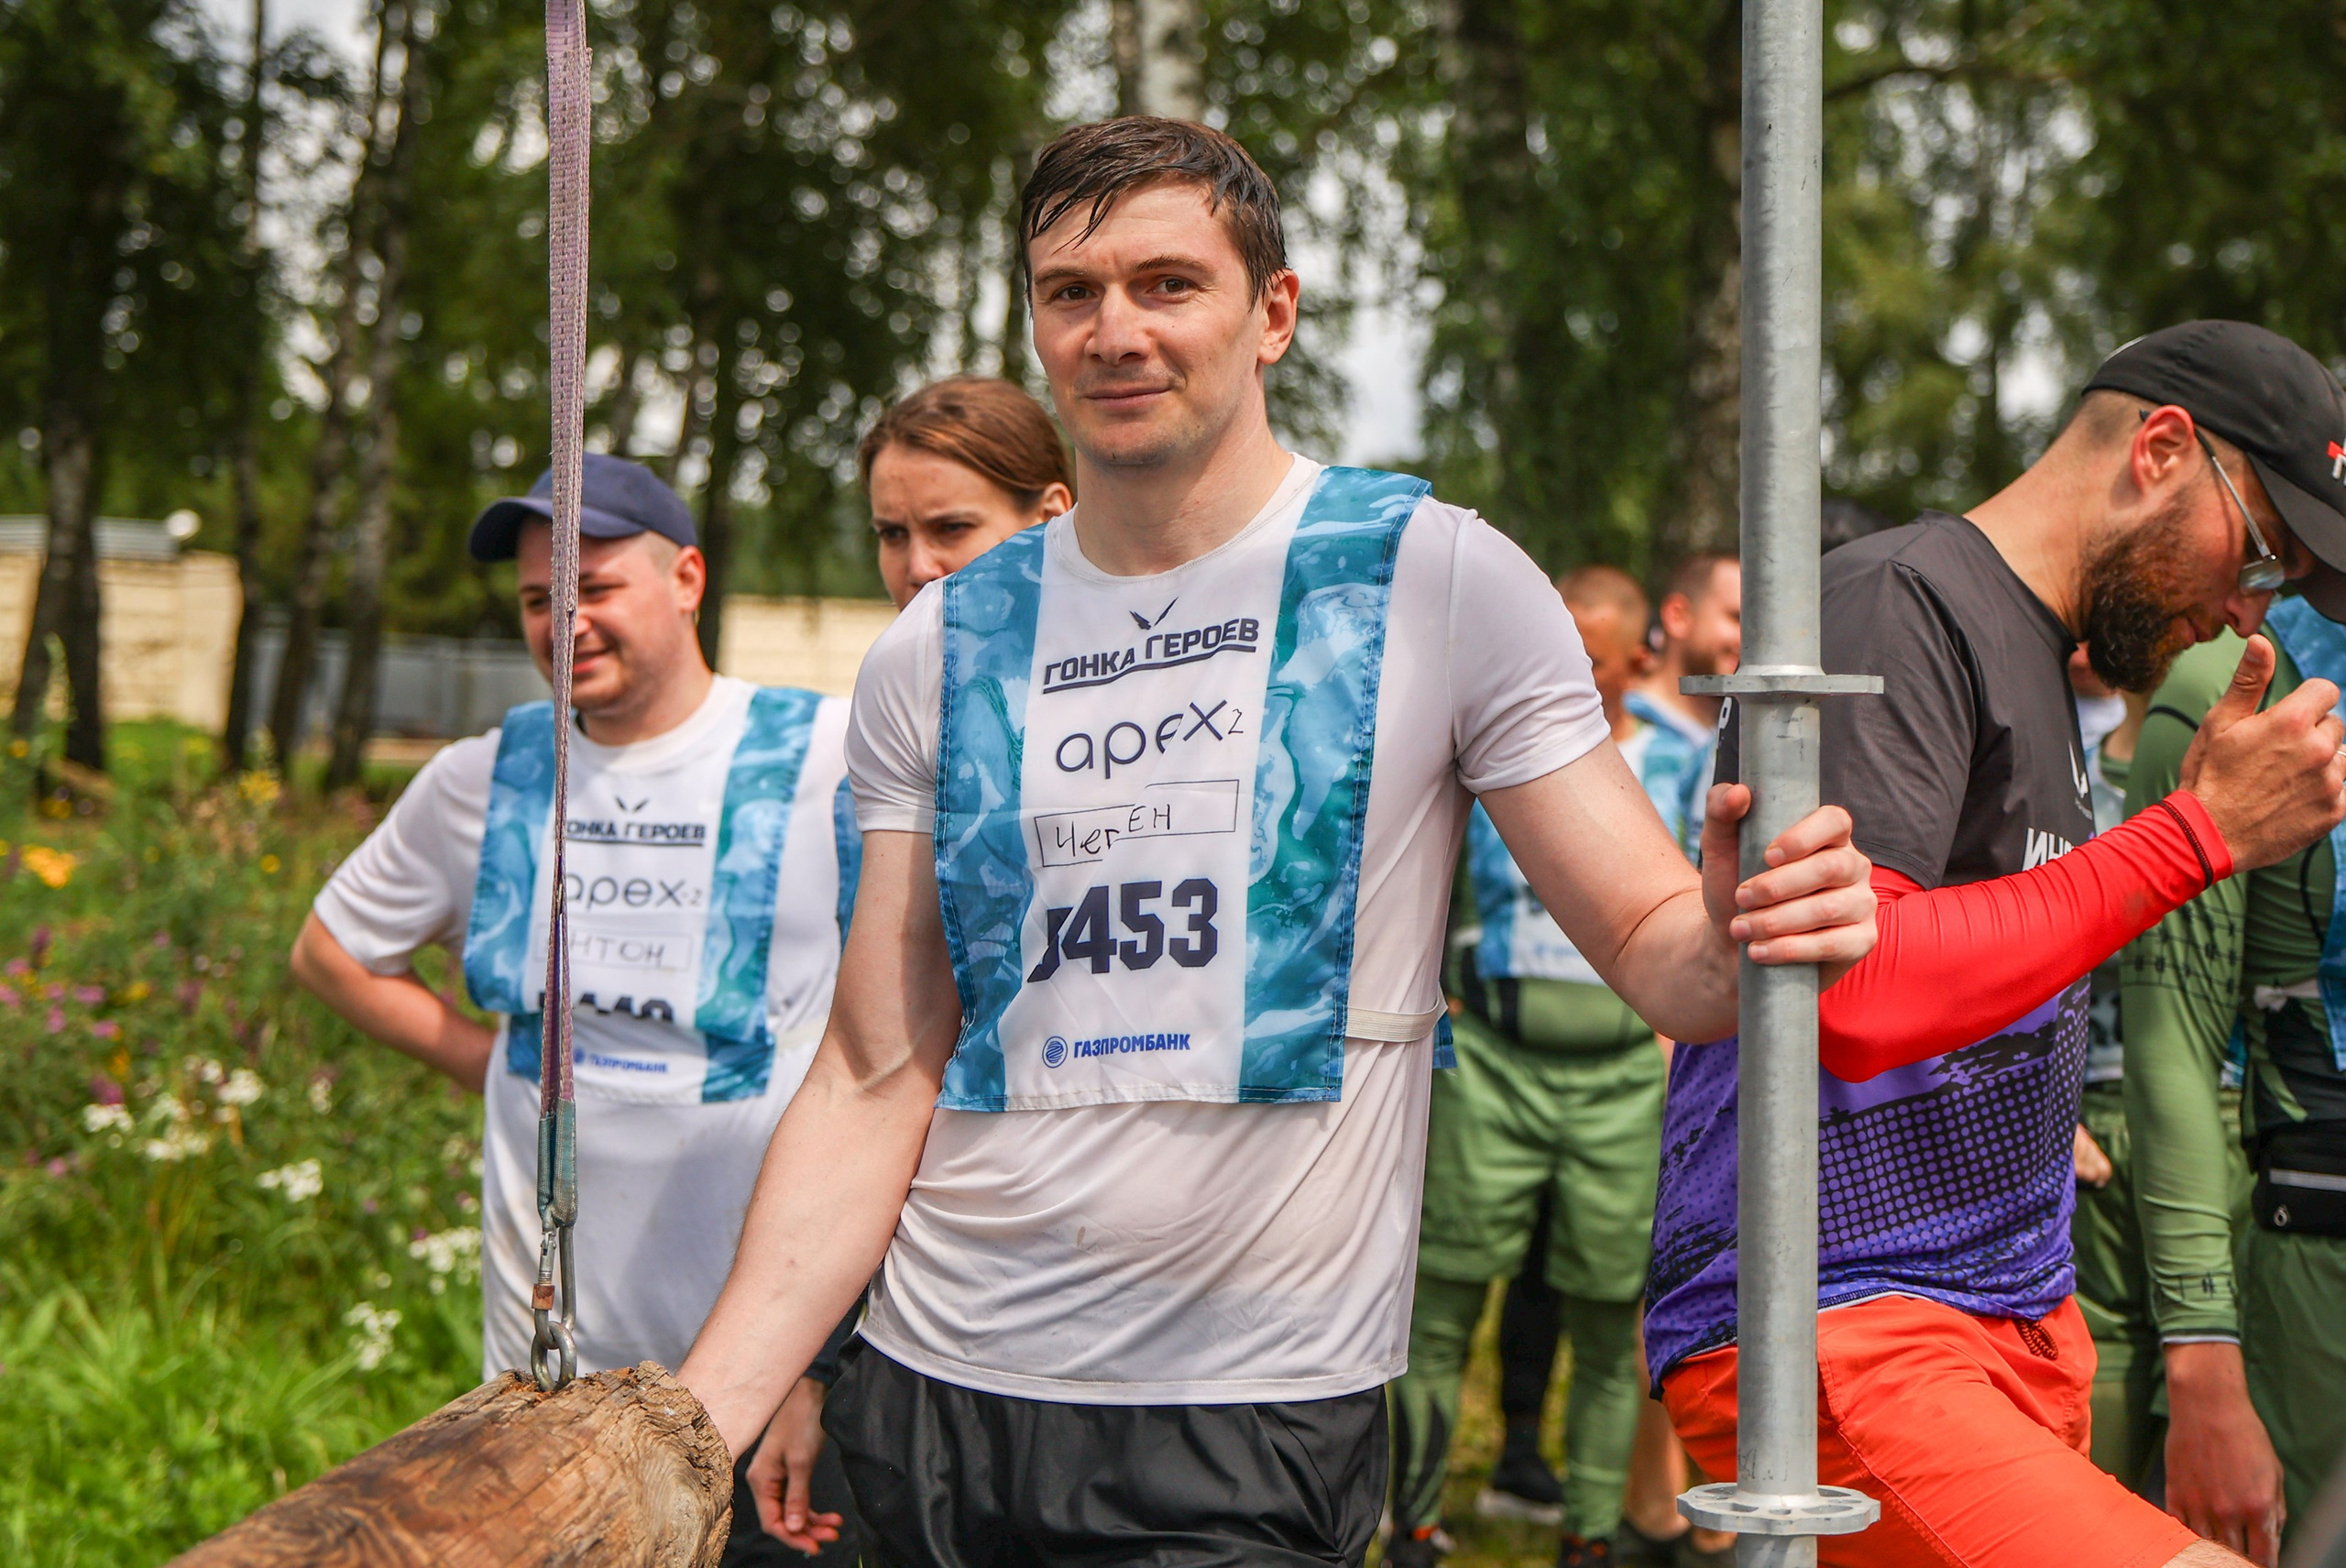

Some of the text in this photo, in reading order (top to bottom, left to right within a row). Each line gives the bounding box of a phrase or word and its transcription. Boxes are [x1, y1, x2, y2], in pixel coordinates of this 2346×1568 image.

[1044, 618, 1260, 685] ГОНКА ГЕРОЕВ
[1056, 699, 1228, 780] apex
[566, 818, 706, 839] ОНКА ГЕРОЕВ
[569, 930, 665, 967] НТОН
[1073, 1034, 1190, 1058] ГАЗПРОМБАНК
